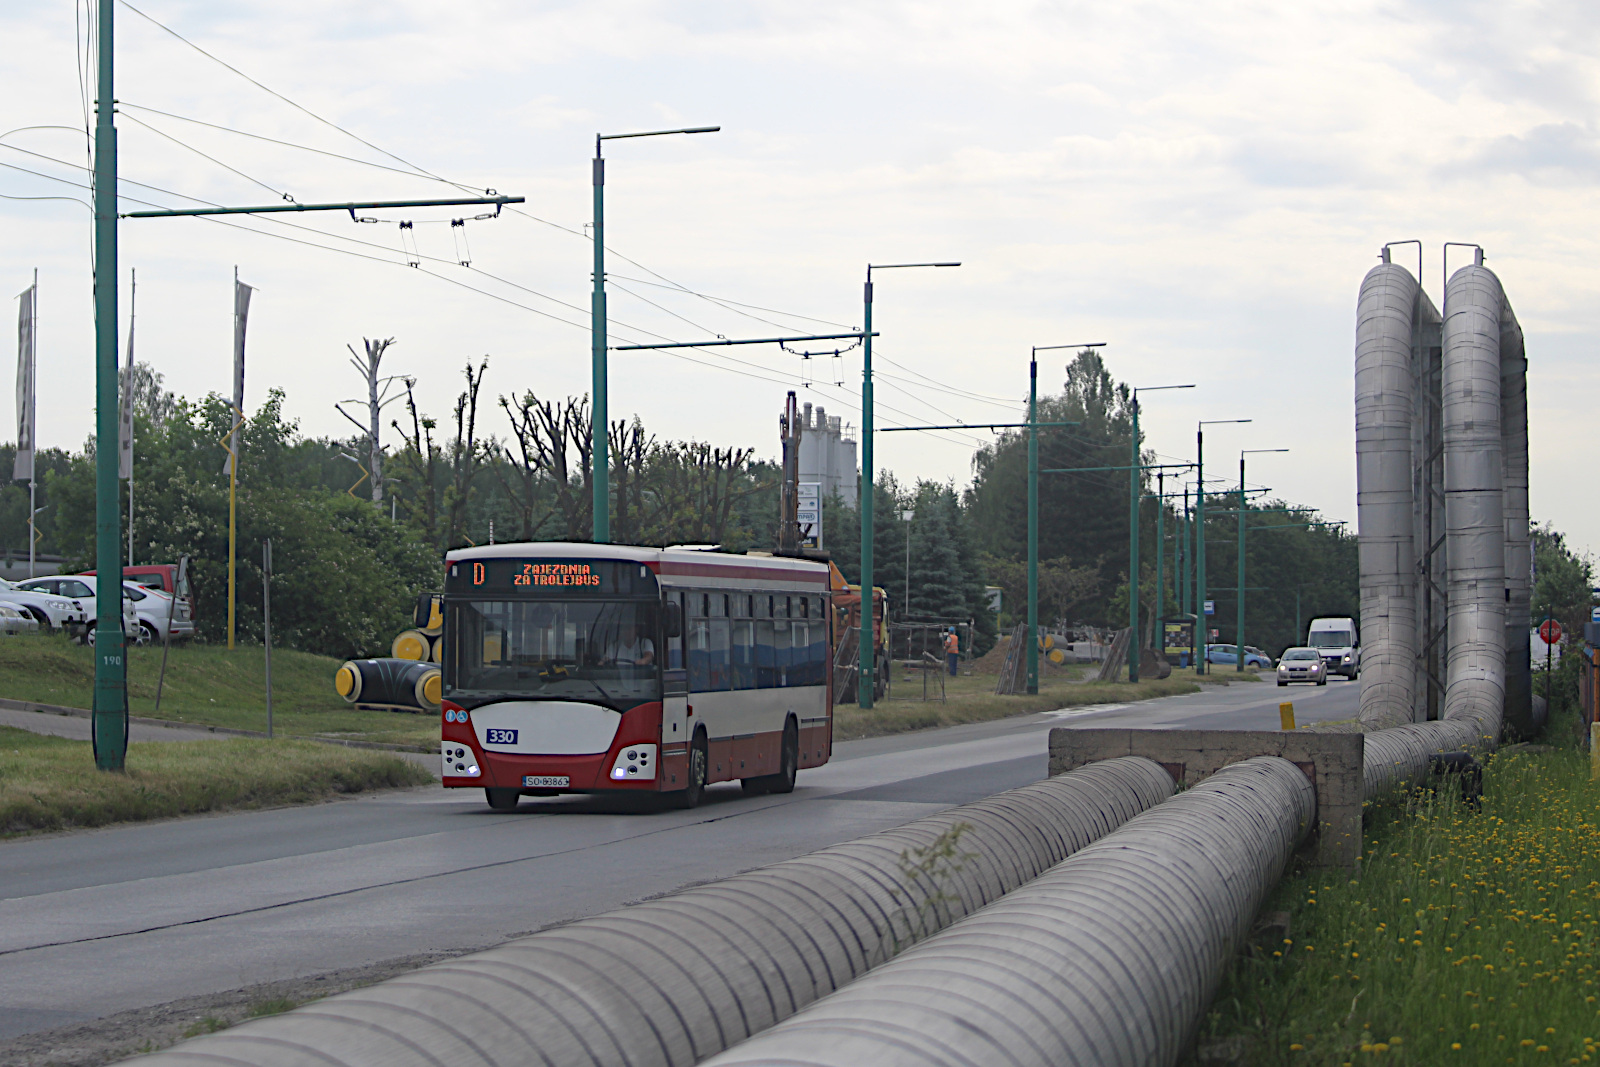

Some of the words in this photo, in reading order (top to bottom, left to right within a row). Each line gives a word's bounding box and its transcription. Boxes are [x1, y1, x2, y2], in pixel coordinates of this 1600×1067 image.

[473, 563, 485, 585] D
[523, 564, 591, 575] ZAJEZDNIA
[514, 575, 531, 585] ZA
[533, 575, 600, 585] TROLEJBUS
[1542, 628, 1560, 636] SOP
[104, 656, 121, 665] 190
[489, 730, 514, 743] 330
[527, 777, 540, 785] SO
